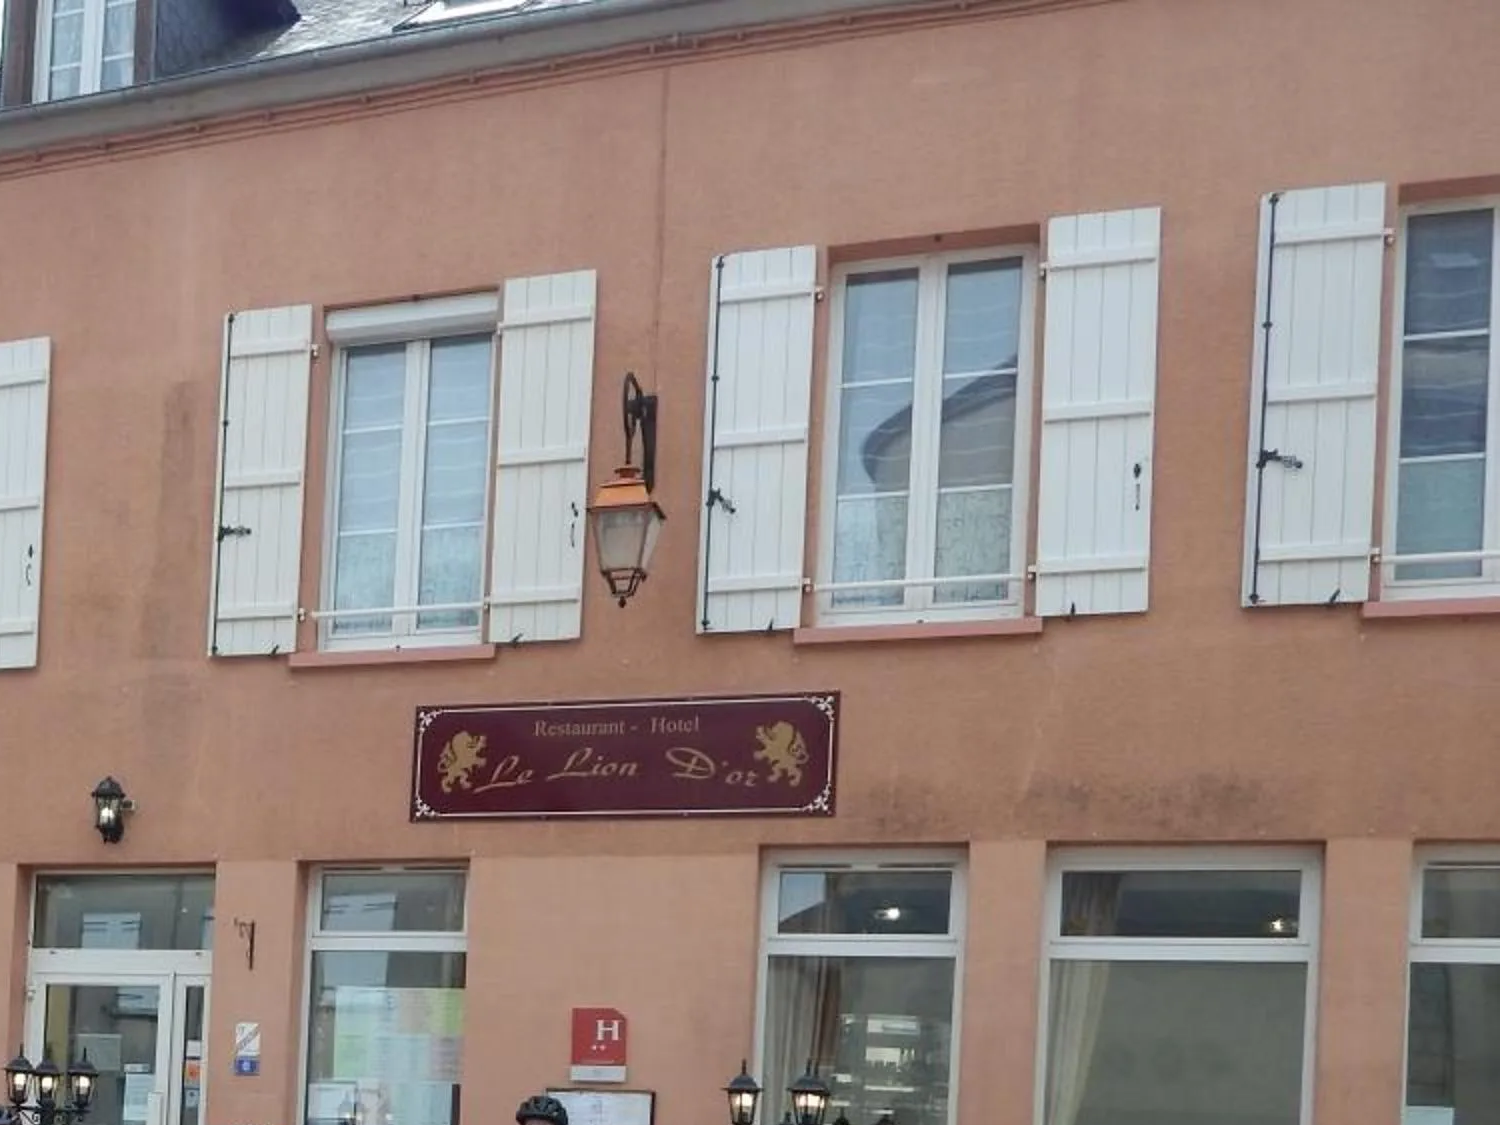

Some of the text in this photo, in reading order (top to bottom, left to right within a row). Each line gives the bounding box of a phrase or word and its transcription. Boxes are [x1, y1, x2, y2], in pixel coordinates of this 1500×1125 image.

[533, 719, 626, 737] Restaurant
[651, 714, 699, 734] Hotel
[473, 755, 535, 794] Le
[546, 747, 638, 782] Lion
[596, 1019, 620, 1041] H
